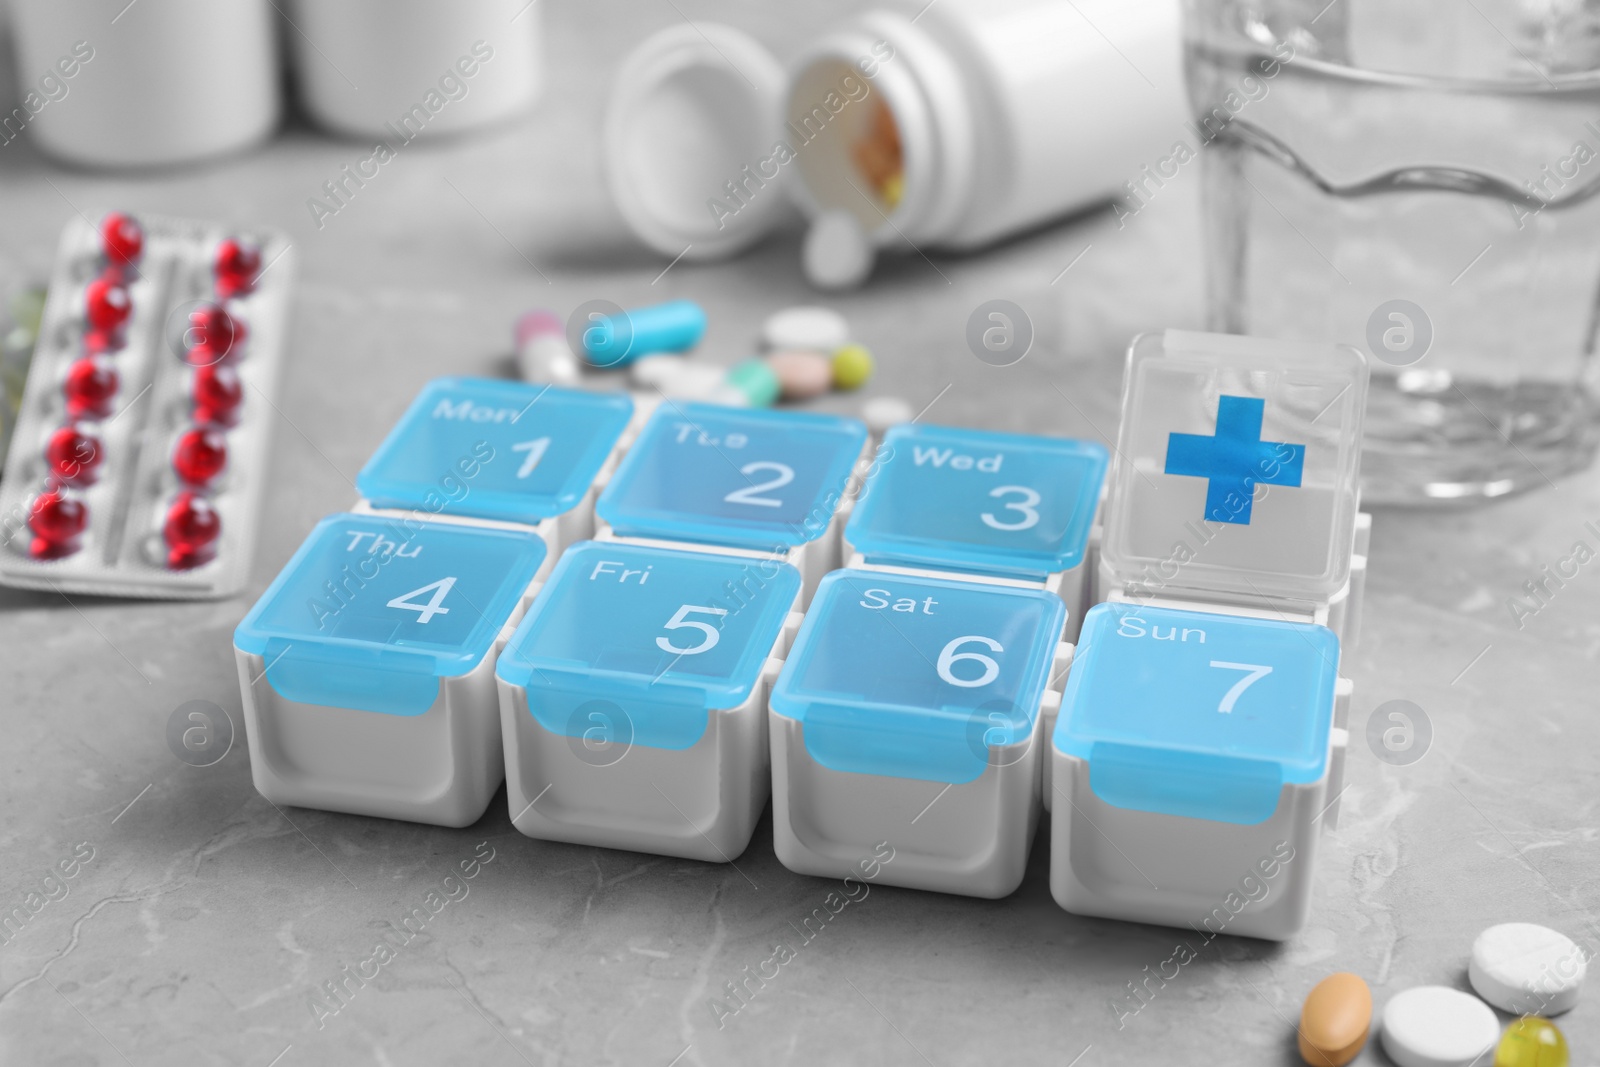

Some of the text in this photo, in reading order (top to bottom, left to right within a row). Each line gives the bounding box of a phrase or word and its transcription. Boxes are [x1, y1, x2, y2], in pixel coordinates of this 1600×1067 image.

[432, 398, 519, 423] Mon
[511, 436, 552, 479] 1
[912, 445, 1003, 473] Wed
[723, 460, 795, 508] 2
[980, 485, 1042, 531] 3
[346, 530, 424, 558] Thu
[589, 560, 653, 585] Fri
[386, 576, 457, 624] 4
[859, 588, 939, 615] Sat
[655, 604, 728, 655] 5
[1116, 616, 1207, 644] Sun
[936, 635, 1004, 688] 6
[1209, 660, 1273, 714] 7
